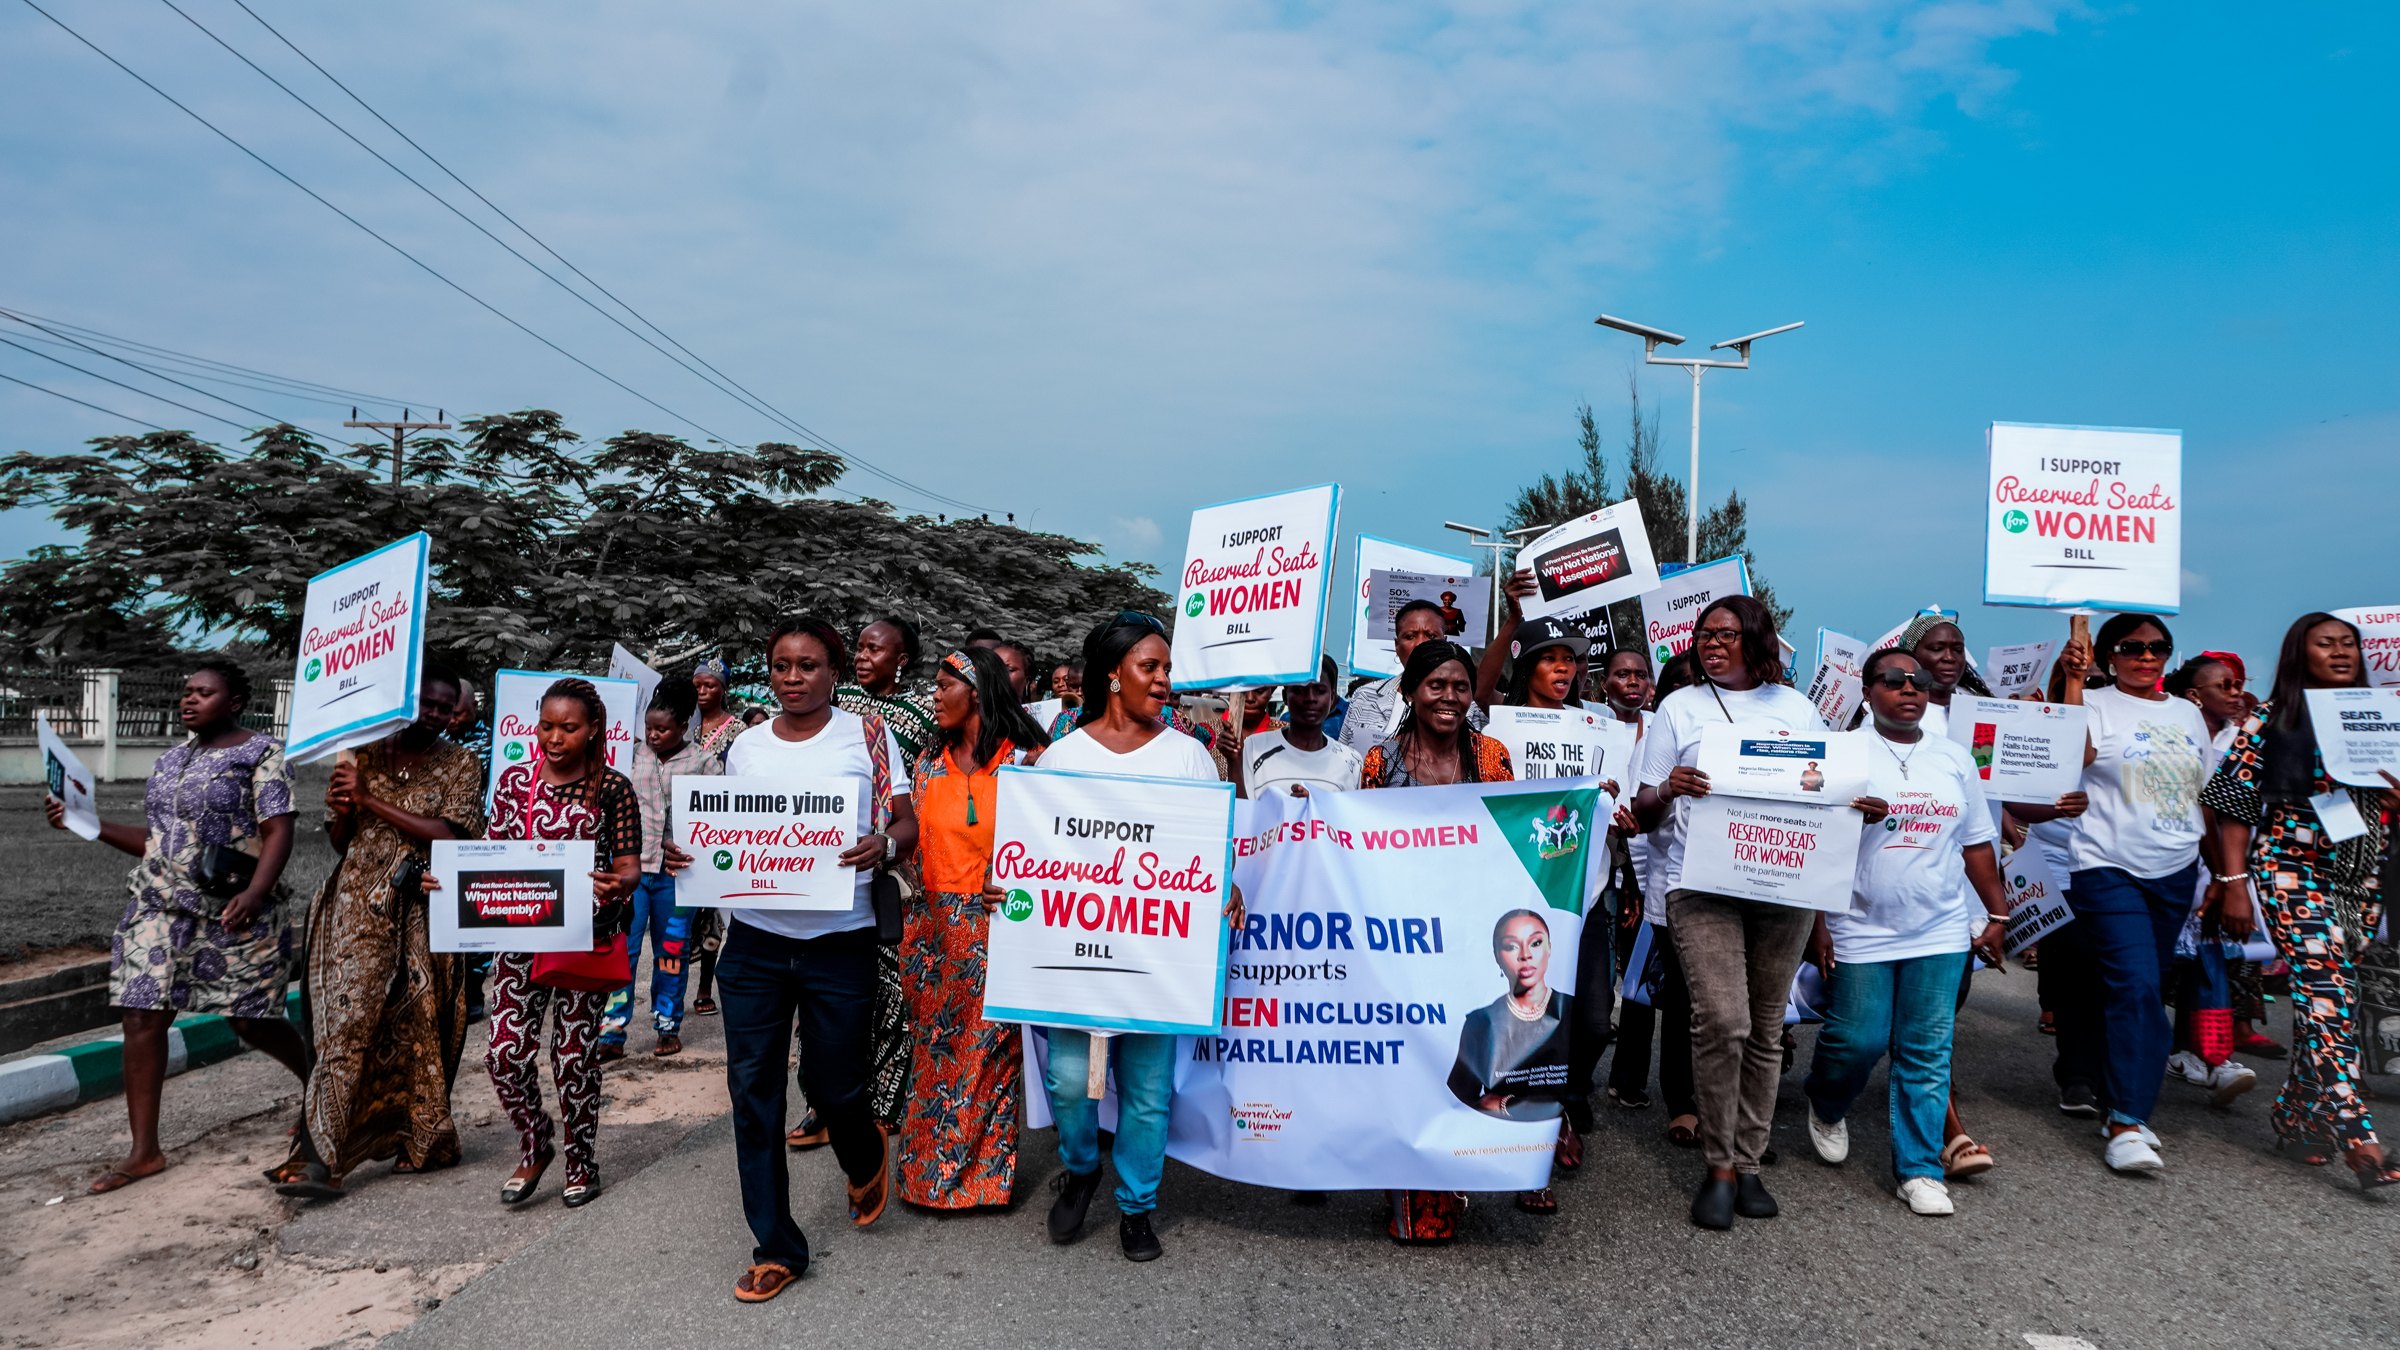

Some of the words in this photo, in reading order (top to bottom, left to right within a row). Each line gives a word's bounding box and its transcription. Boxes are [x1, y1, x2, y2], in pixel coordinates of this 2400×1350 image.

[2041, 457, 2045, 471] I
[2050, 458, 2121, 476] SUPPORT
[1995, 475, 2099, 507] Reserved
[2107, 482, 2175, 511] Seats
[1222, 534, 1226, 549] I
[1229, 525, 1283, 548] SUPPORT
[2006, 512, 2028, 530] for
[2034, 510, 2156, 544] WOMEN
[1541, 564, 1563, 578] Why
[1564, 557, 1581, 570] Not
[1581, 546, 1619, 565] National
[2064, 548, 2095, 560] BILL
[1184, 546, 1264, 589] Reserved
[1267, 541, 1318, 577] Seats
[1560, 561, 1608, 585] Assembly?
[333, 600, 337, 614] I
[339, 582, 380, 611] SUPPORT
[1187, 596, 1204, 615] for
[1210, 578, 1302, 617] WOMEN
[1389, 589, 1410, 597] 50%
[1667, 601, 1671, 612] I
[1673, 591, 1711, 611] SUPPORT
[303, 604, 366, 657] Reserved
[369, 591, 408, 630] Seats
[1226, 622, 1251, 635] BILL
[1649, 607, 1701, 643] Reserve
[2356, 615, 2361, 624] I
[2365, 613, 2400, 624] SUPP
[1545, 622, 1563, 638] LA
[306, 662, 320, 680] for
[325, 625, 395, 677] WOMEN
[2360, 637, 2400, 649] serve
[1837, 648, 1854, 659] SUPPORT
[2003, 664, 2018, 675] PASS
[2020, 662, 2032, 673] THE
[339, 675, 358, 690] BILL
[1807, 684, 1819, 701] KWA
[1815, 664, 1829, 685] IBOM
[1827, 678, 1842, 701] Seats
[2000, 676, 2013, 687] BILL
[2014, 674, 2029, 684] NOW
[1826, 694, 1845, 720] Women
[2339, 711, 2382, 720] SEATS
[2342, 722, 2400, 731] RESERVE
[2004, 733, 2022, 742] From
[2024, 735, 2051, 744] Lecture
[506, 743, 523, 758] for
[1526, 742, 1556, 760] PASS
[1561, 744, 1584, 762] THE
[2001, 750, 2030, 758] Women
[1526, 763, 1547, 780] BILL
[1556, 763, 1584, 778] NOW
[2001, 758, 2035, 767] Reserved
[2036, 761, 2059, 769] Seats!
[689, 790, 729, 812] Ami
[734, 794, 787, 813] mme
[792, 792, 844, 815] yime
[1900, 791, 1933, 799] SUPPORT
[1727, 808, 1742, 817] Not
[1743, 810, 1759, 820] just
[1759, 814, 1782, 823] more
[1783, 816, 1807, 827] seats
[1808, 819, 1822, 829] but
[1888, 801, 1926, 815] served
[1925, 799, 1960, 818] Seats
[688, 821, 785, 848] Reserved
[783, 822, 844, 848] Seats
[1054, 816, 1060, 835] I
[1066, 817, 1154, 843] SUPPORT
[1311, 819, 1354, 850] FOR
[1362, 824, 1479, 850] WOMEN
[1898, 816, 1941, 834] Women
[2152, 818, 2193, 832] LOVE
[1727, 821, 1783, 846] RESERVED
[1785, 831, 1816, 851] SEATS
[1903, 836, 1918, 844] BILL
[715, 852, 731, 867] for
[738, 849, 815, 873] Women
[1734, 842, 1757, 862] FOR
[1760, 846, 1805, 869] WOMEN
[995, 841, 1126, 886] Reserved
[1133, 851, 1217, 893] Seats
[1733, 862, 1741, 871] in
[1743, 864, 1757, 874] the
[1757, 867, 1801, 880] parliament
[751, 879, 778, 889] BILL
[465, 891, 490, 903] Why
[492, 890, 511, 901] Not
[513, 889, 557, 901] National
[481, 904, 541, 916] Assembly?
[1005, 891, 1032, 916] for
[1041, 889, 1191, 939] WOMEN
[2039, 905, 2067, 928] IBAN
[1229, 912, 1354, 955] RNOR
[1365, 915, 1444, 954] DIRI
[2016, 920, 2041, 944] AKWA
[1074, 943, 1113, 959] BILL
[1229, 959, 1347, 986] supports
[1284, 1002, 1447, 1025] INCLUSION
[1192, 1036, 1210, 1062] IN
[1215, 1038, 1405, 1065] PARLIAMENT
[1230, 1105, 1270, 1119] Reserved
[1248, 1119, 1281, 1131] Women
